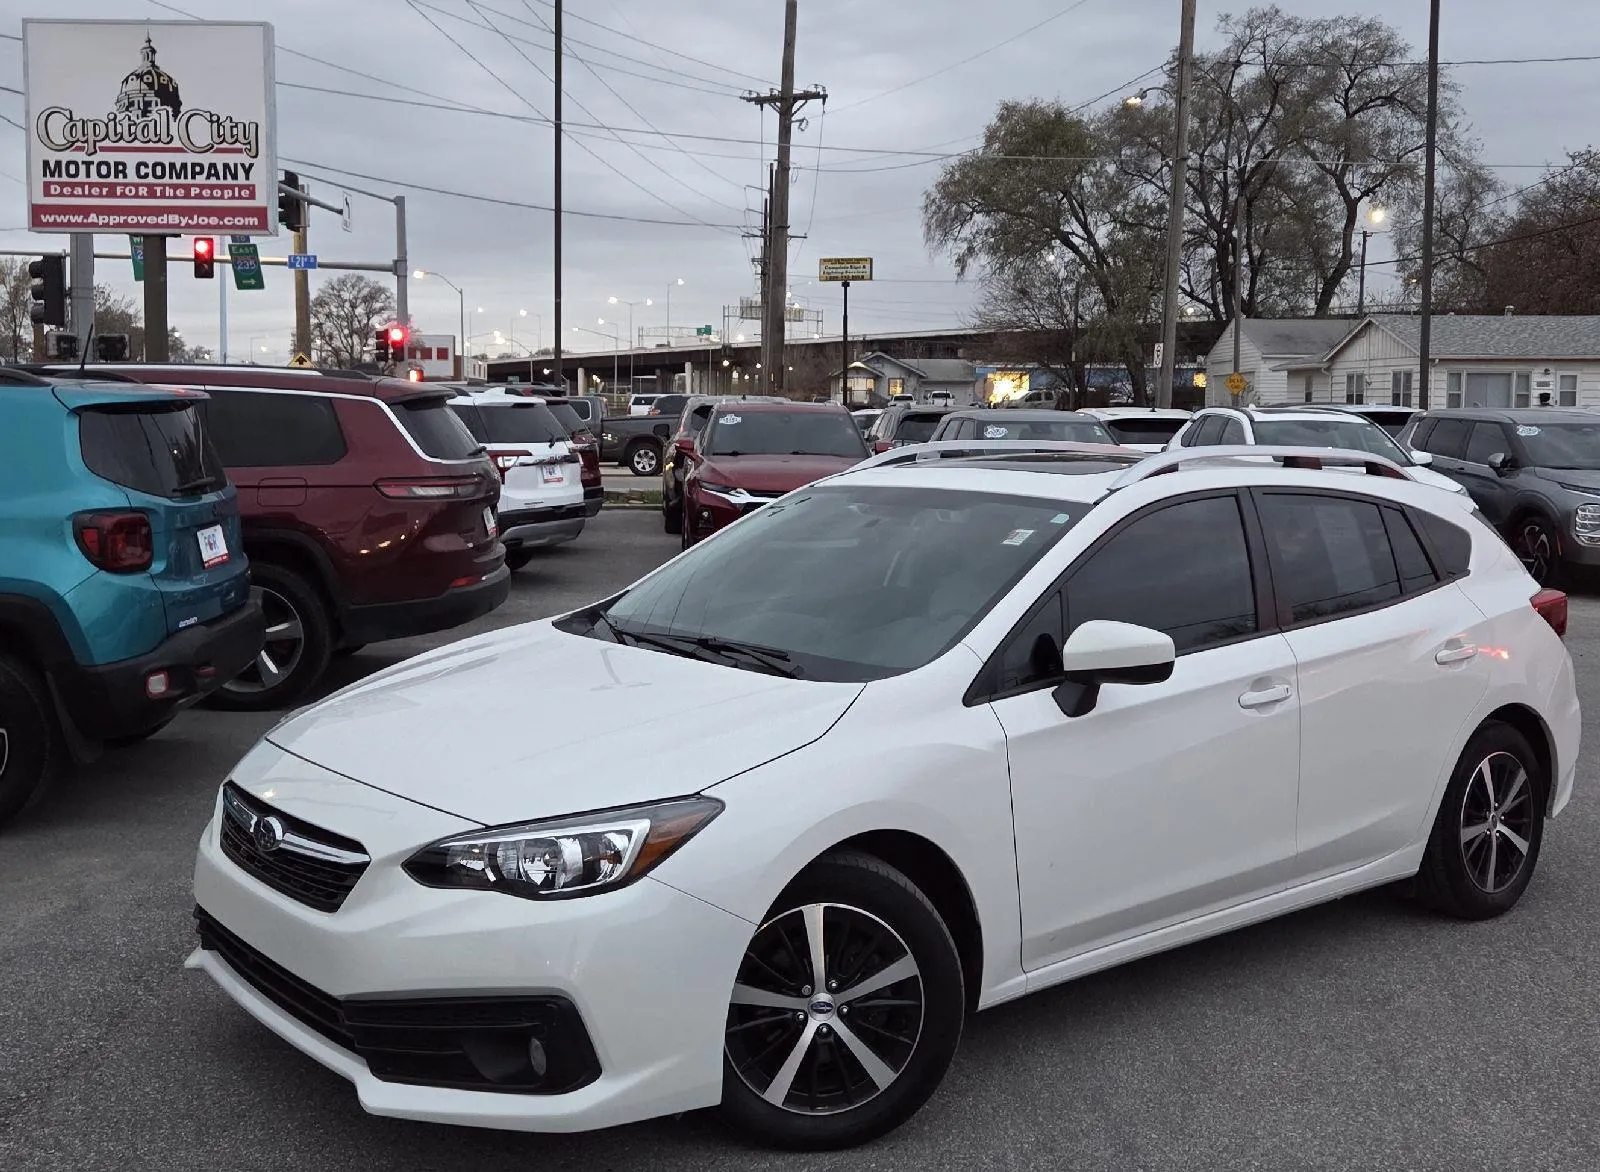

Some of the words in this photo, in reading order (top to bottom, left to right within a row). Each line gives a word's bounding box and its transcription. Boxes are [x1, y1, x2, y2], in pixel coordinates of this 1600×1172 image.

[37, 106, 174, 156] Capital
[178, 109, 259, 158] City
[42, 160, 128, 179] MOTOR
[135, 161, 255, 181] COMPANY
[50, 184, 109, 195] Dealer
[116, 186, 148, 197] FOR
[154, 187, 185, 197] The
[190, 187, 250, 199] People
[40, 213, 259, 227] www.ApprovedByJoe.com
[236, 259, 256, 270] 235
